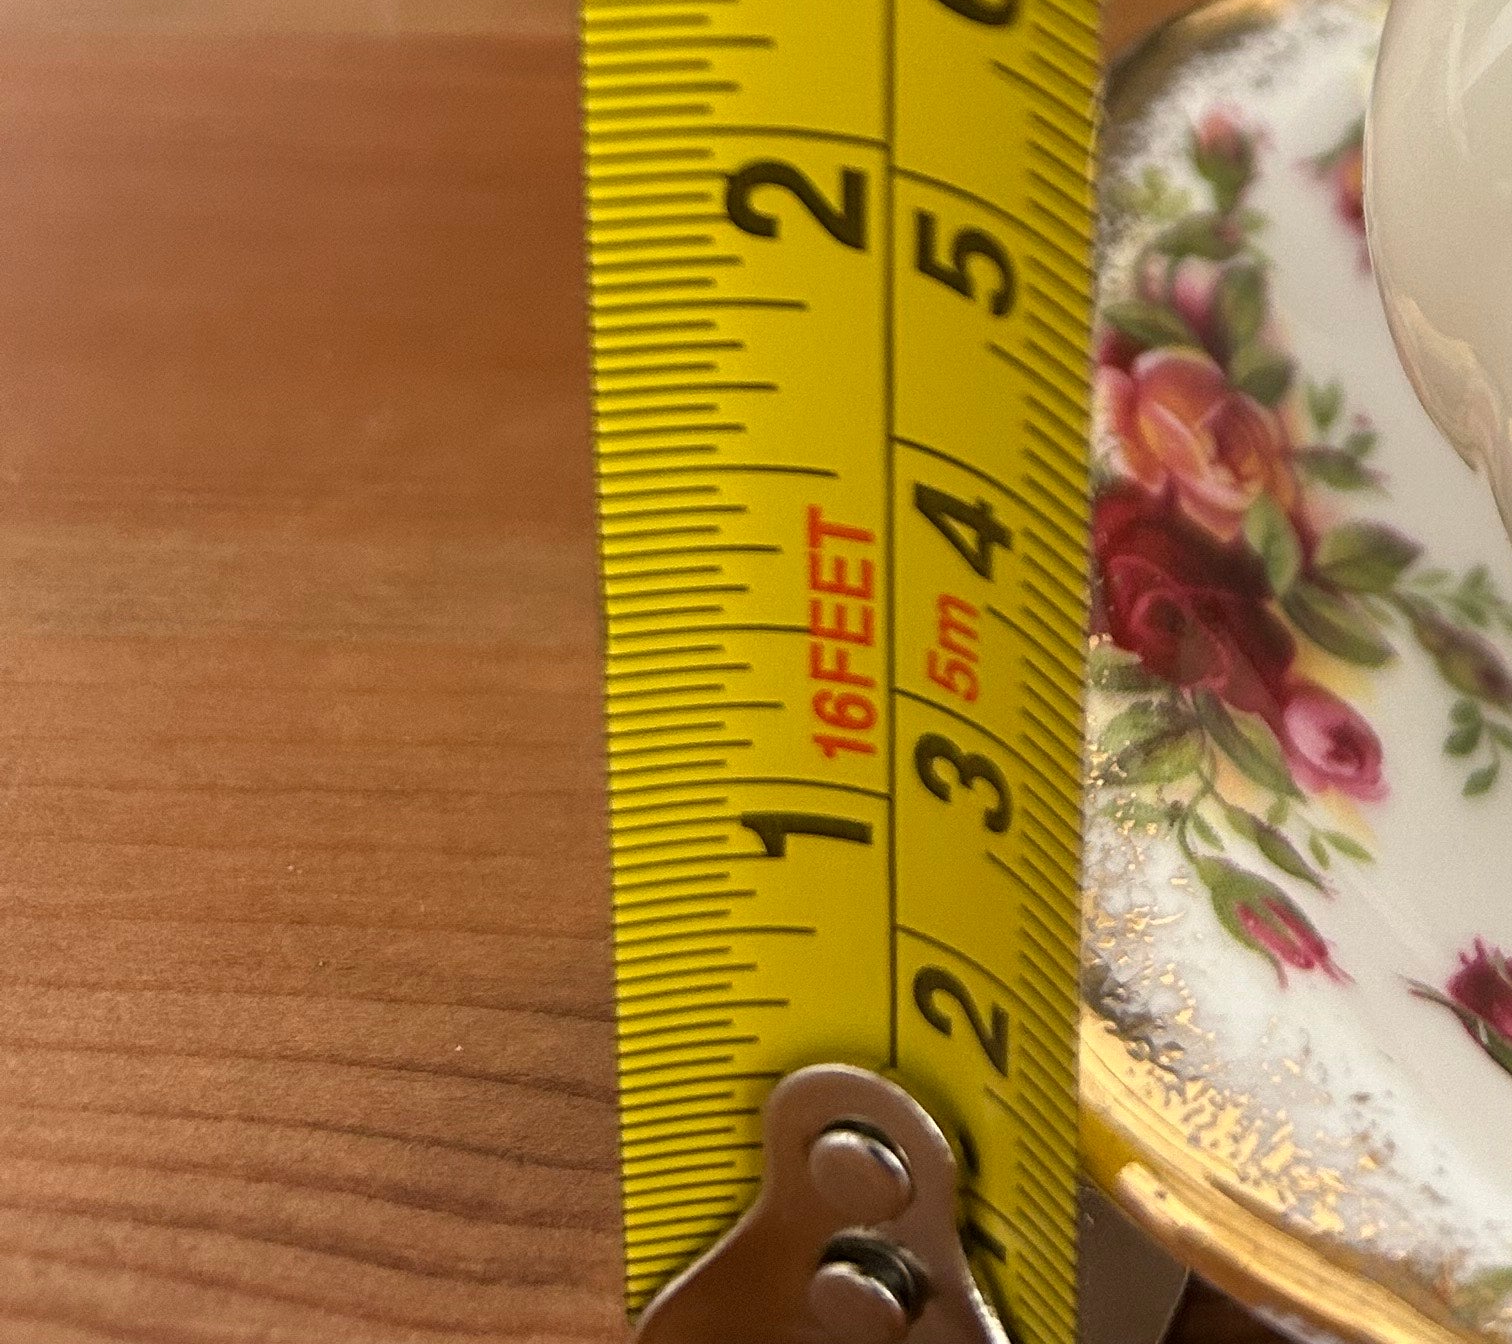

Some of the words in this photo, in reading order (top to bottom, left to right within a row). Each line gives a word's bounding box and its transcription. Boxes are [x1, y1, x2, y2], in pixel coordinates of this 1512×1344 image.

[724, 157, 870, 253] 2
[912, 209, 1018, 318] 5
[912, 482, 1014, 582] 4
[807, 503, 878, 759] 16FEET
[927, 593, 980, 704] 5m
[740, 810, 874, 858] 1
[913, 730, 1013, 834] 3
[912, 964, 1009, 1078] 2
